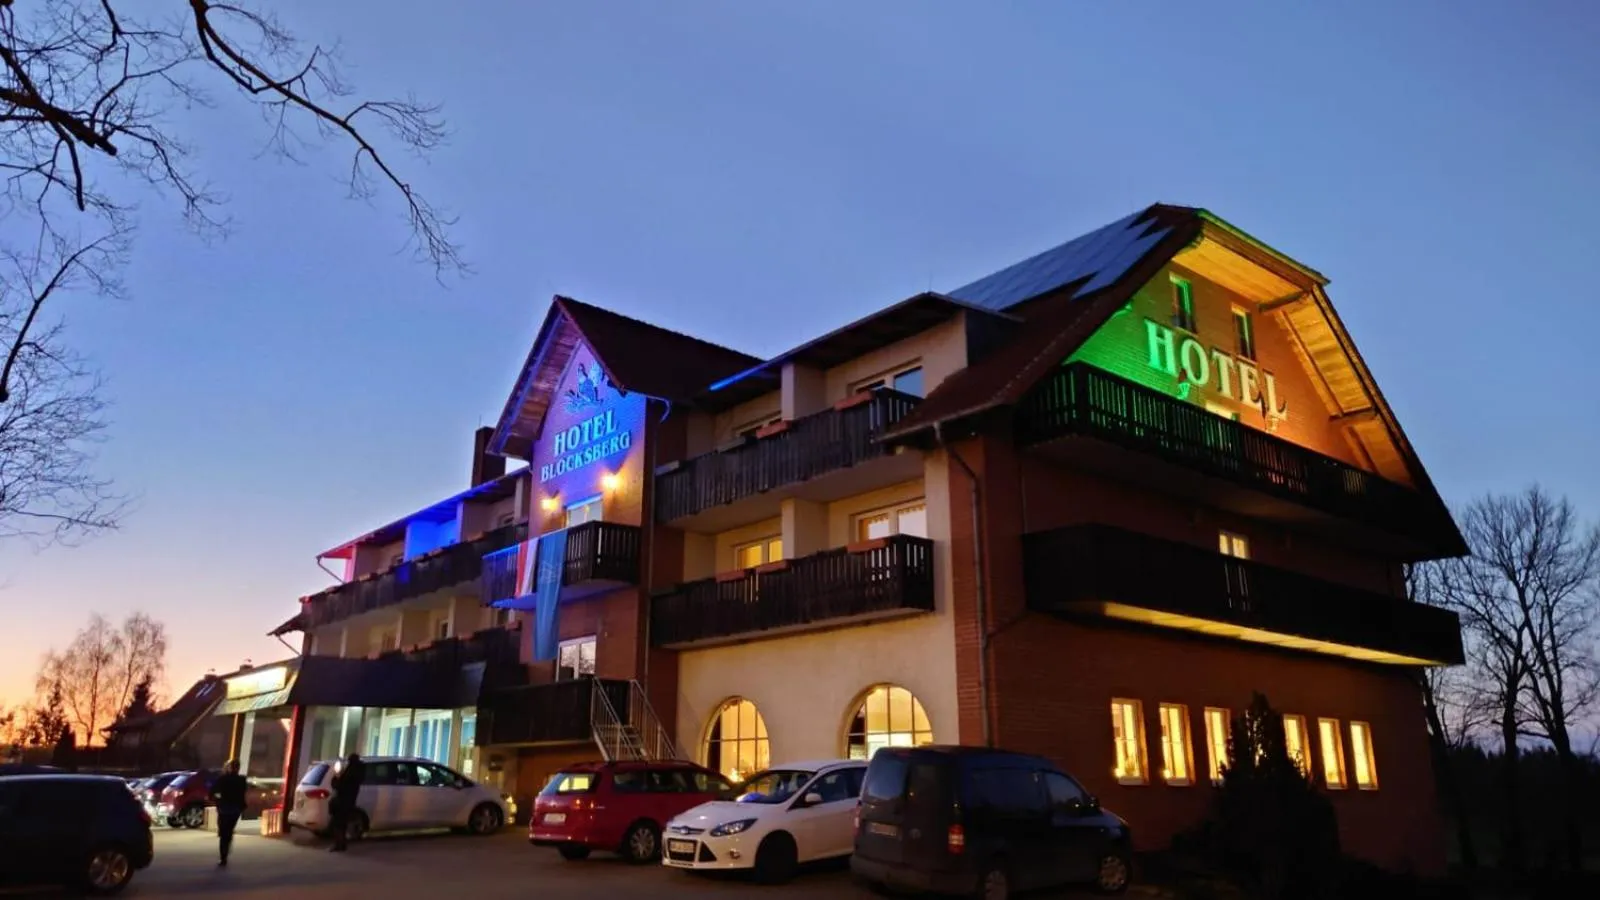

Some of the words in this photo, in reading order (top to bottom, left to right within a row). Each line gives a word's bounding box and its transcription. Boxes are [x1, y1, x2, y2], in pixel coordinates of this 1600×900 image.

[1145, 319, 1287, 421] HOTEL
[541, 432, 631, 482] BLOCKSBERG
[554, 410, 616, 457] HOTEL
